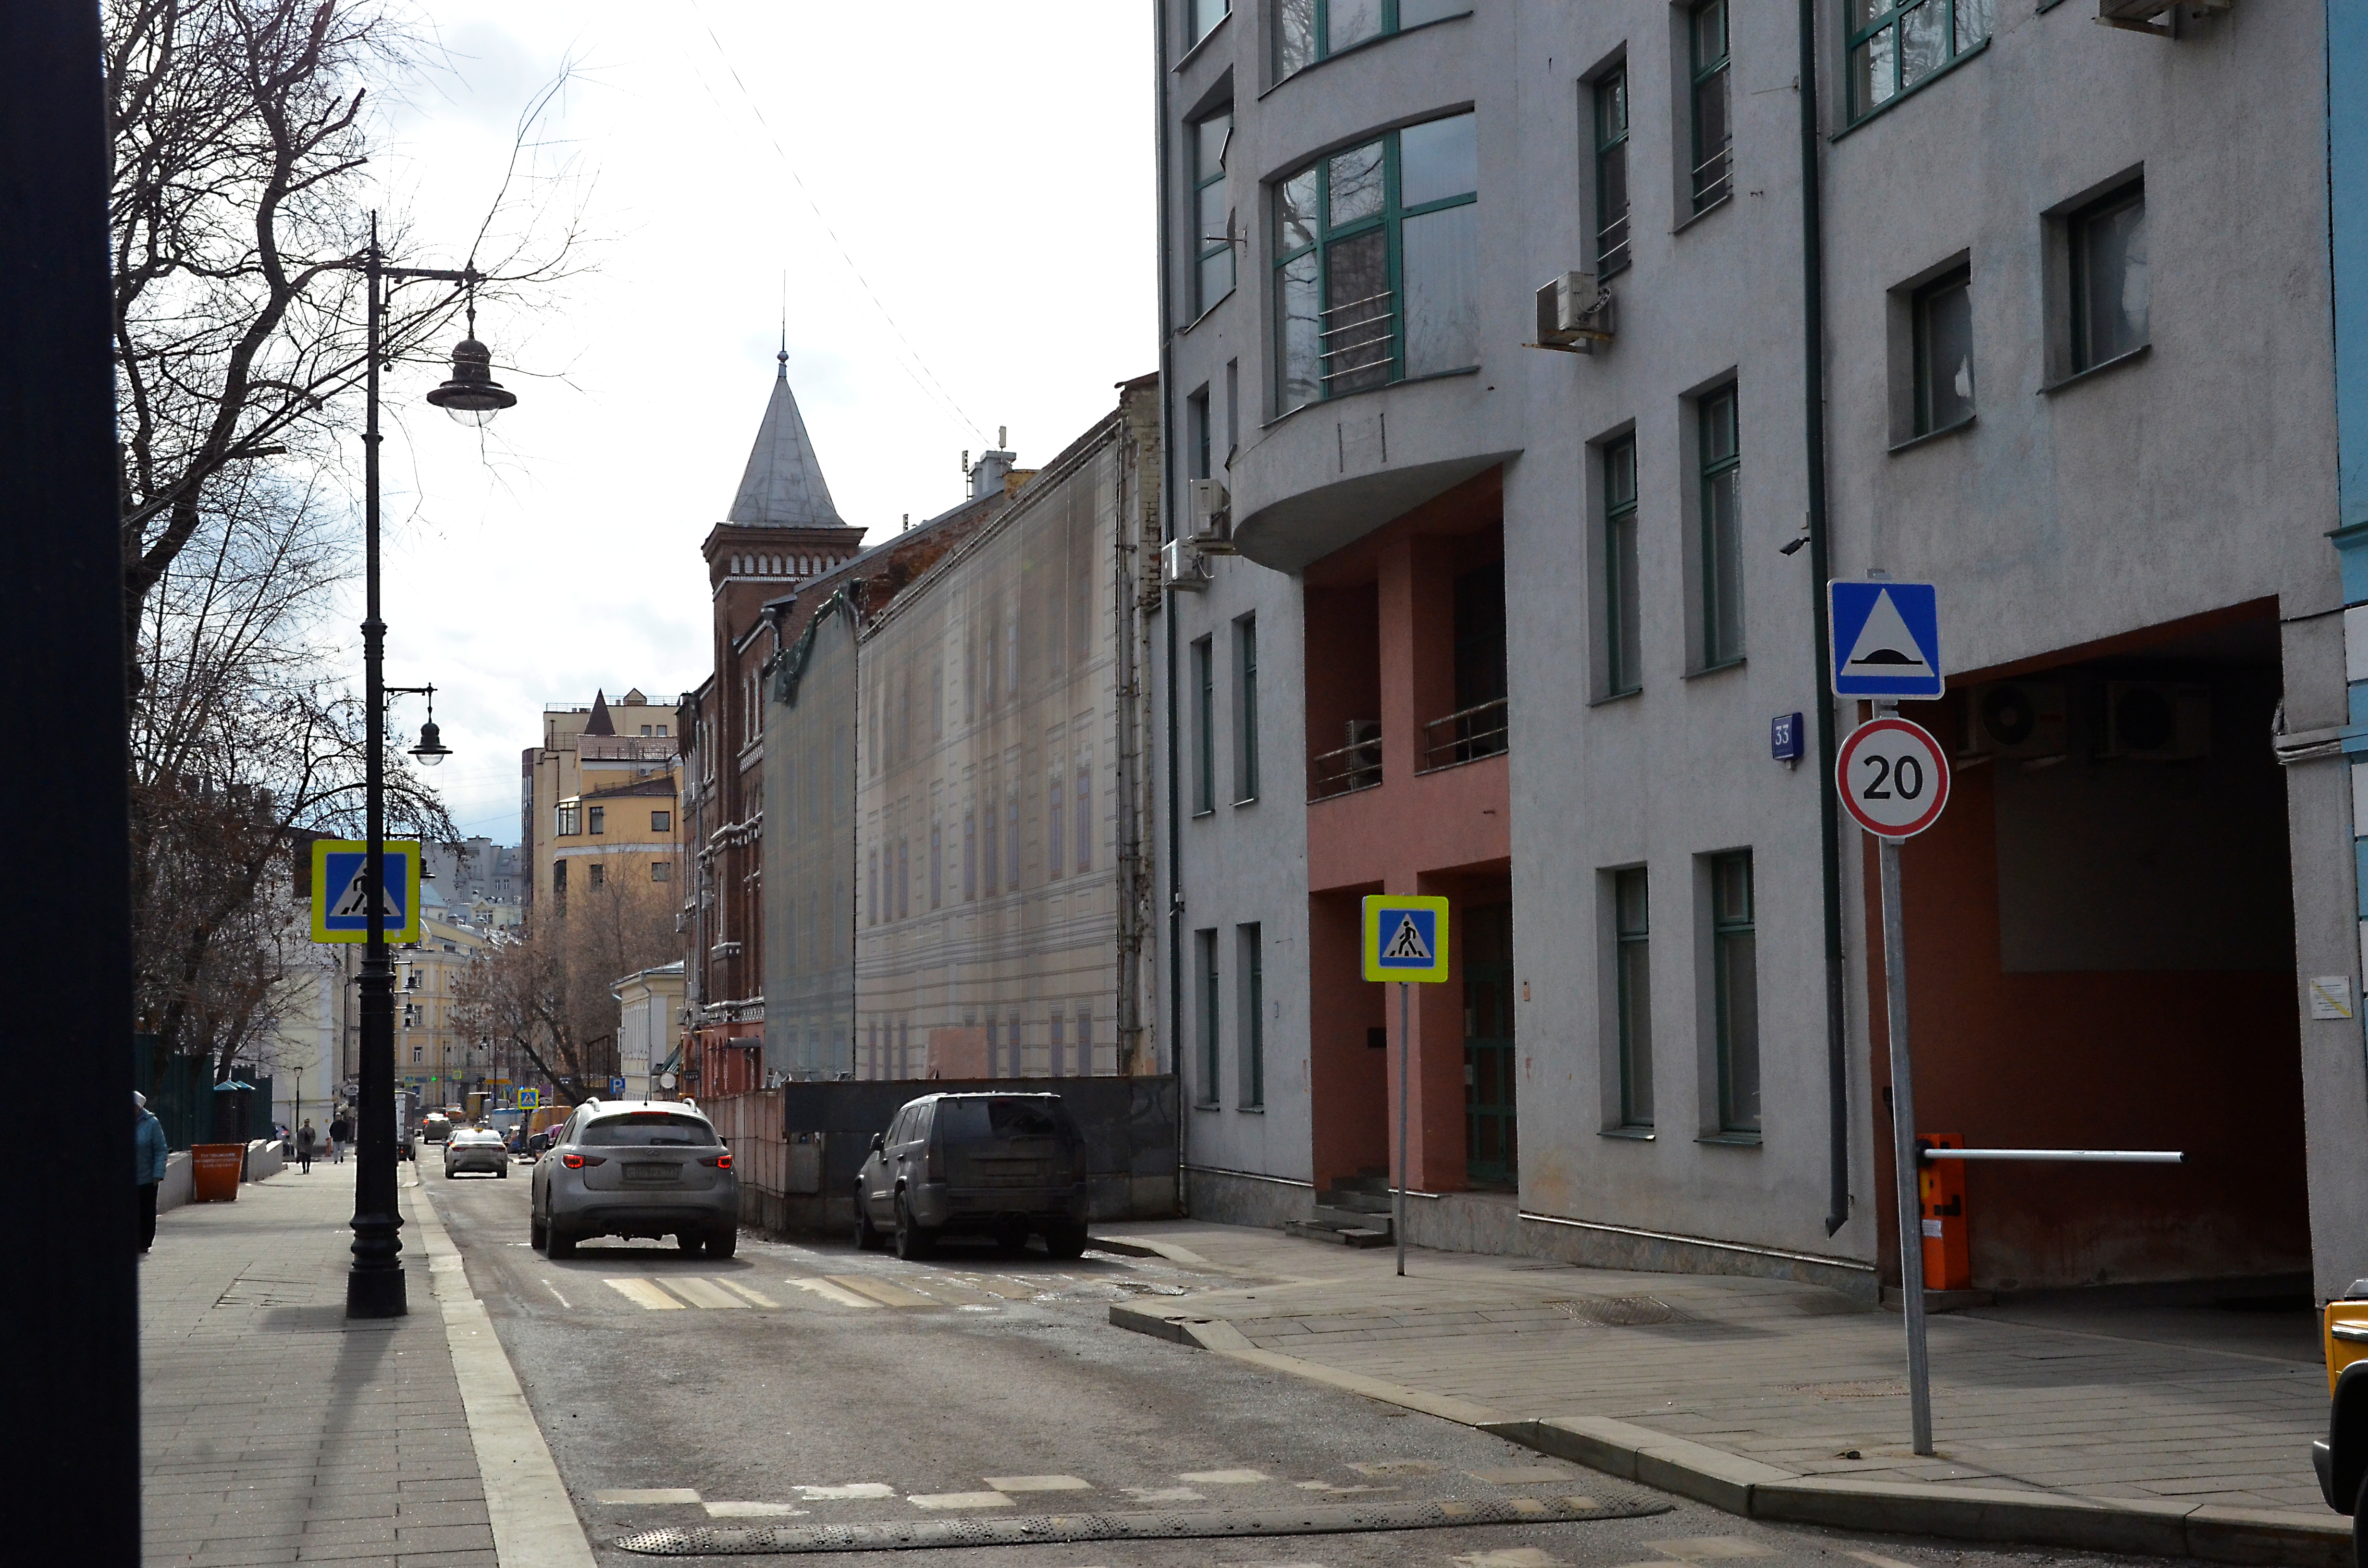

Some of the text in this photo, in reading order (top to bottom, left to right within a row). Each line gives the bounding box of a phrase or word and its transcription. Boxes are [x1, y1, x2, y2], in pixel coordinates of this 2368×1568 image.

[1776, 724, 1789, 745] 33
[1863, 755, 1923, 800] 20
[614, 1079, 622, 1092] P
